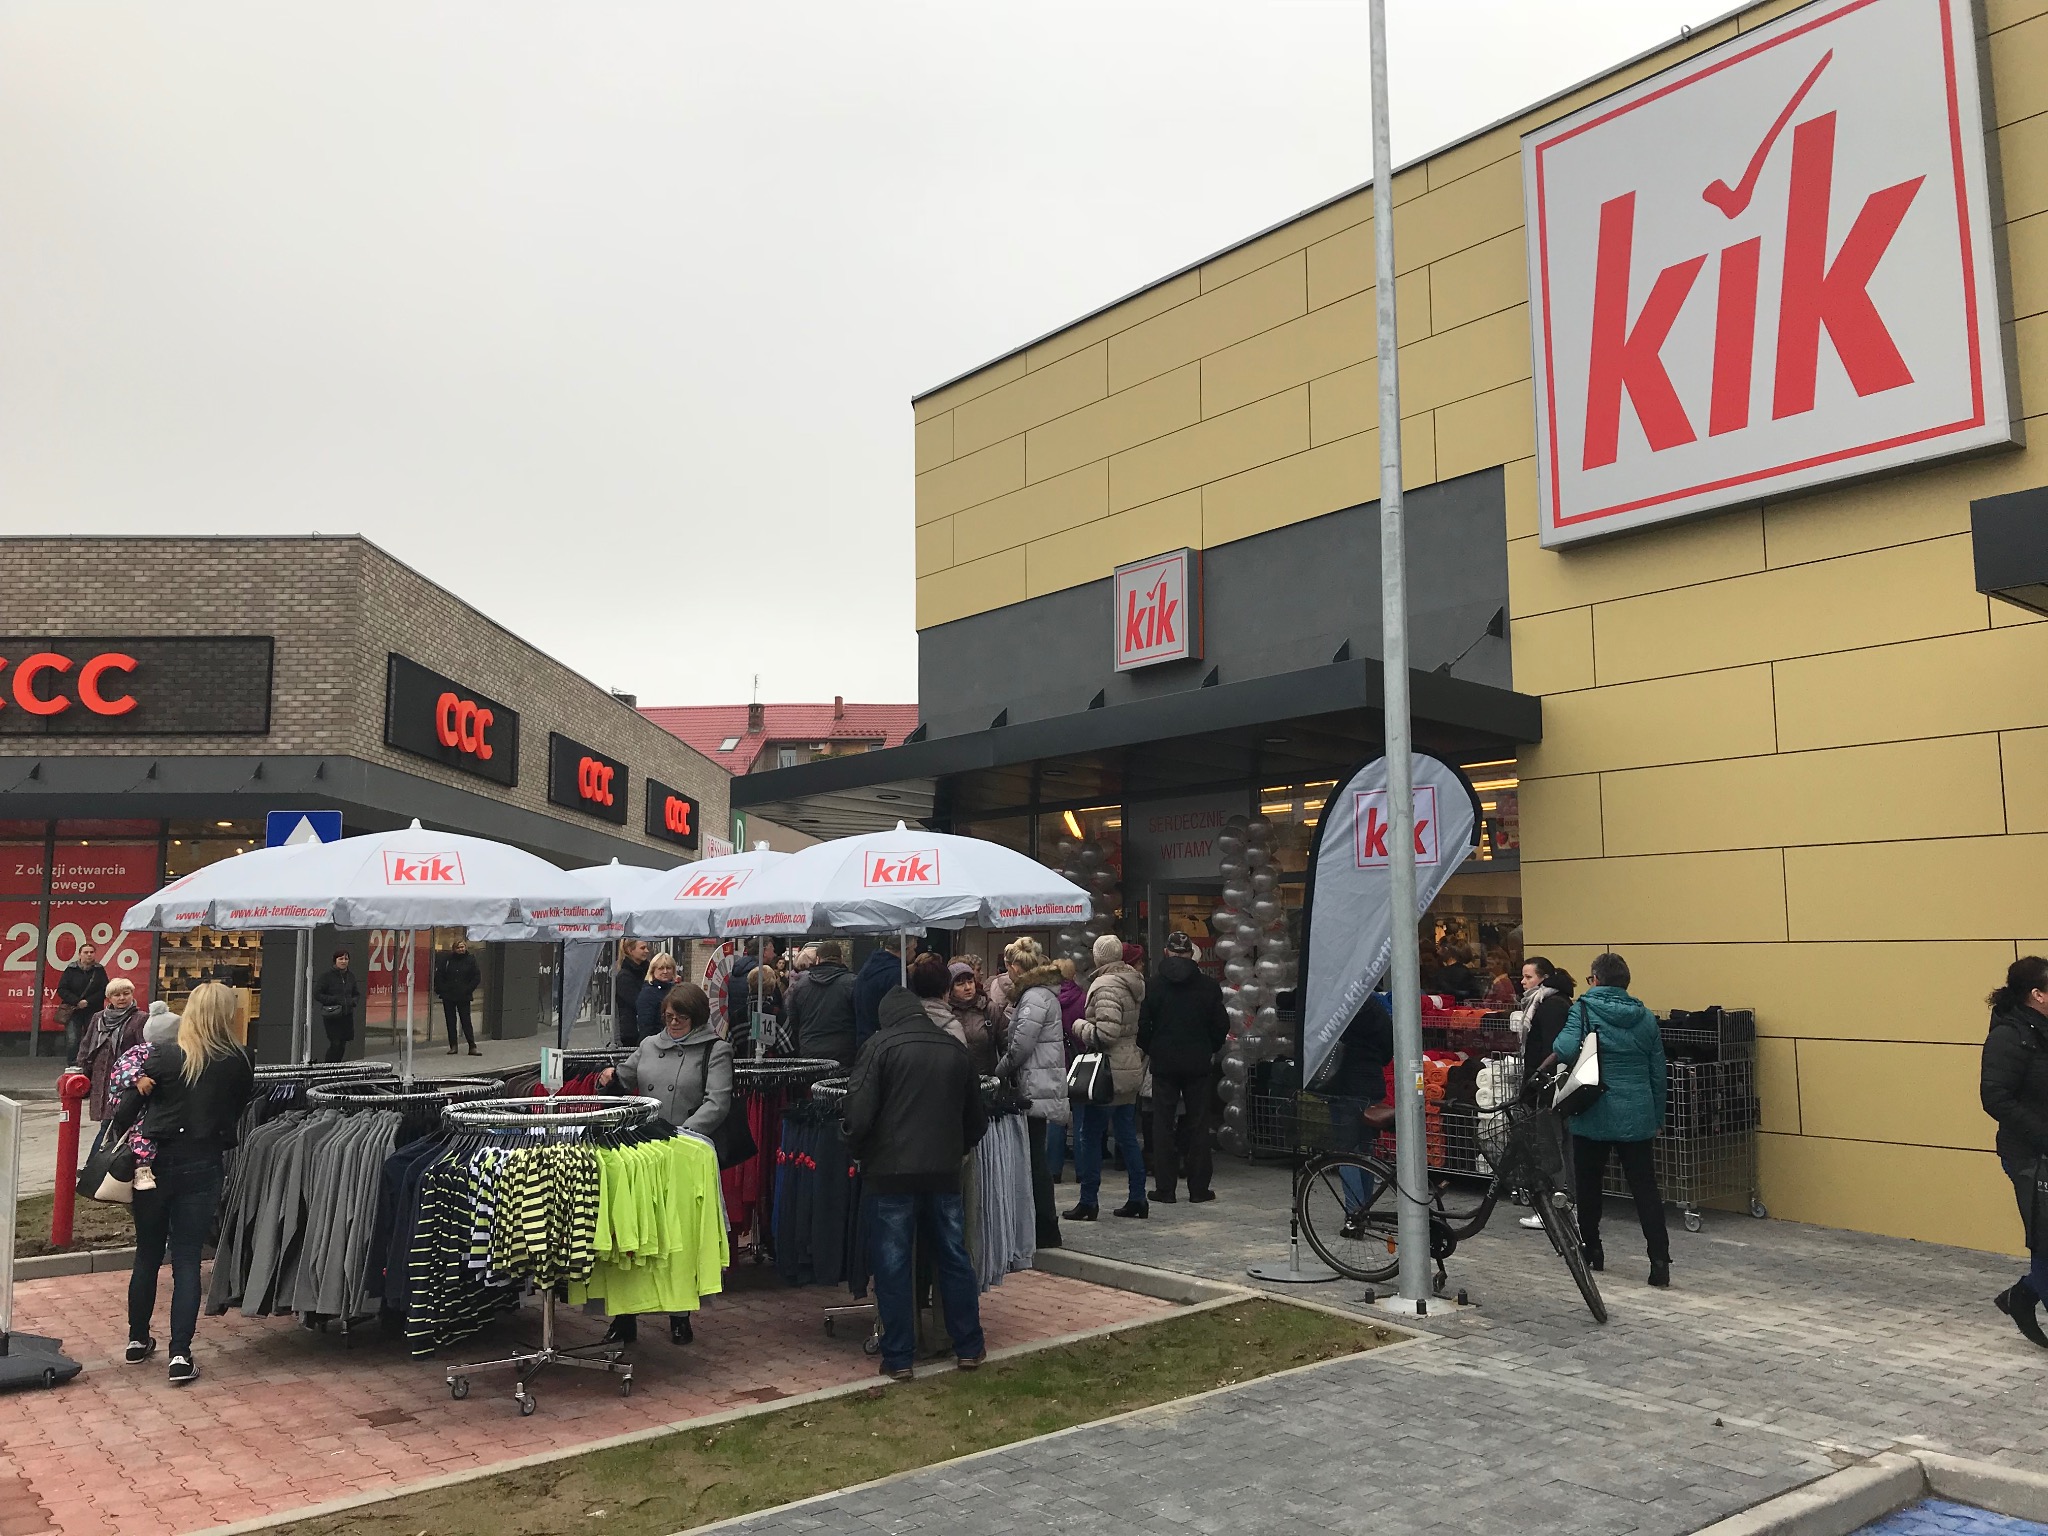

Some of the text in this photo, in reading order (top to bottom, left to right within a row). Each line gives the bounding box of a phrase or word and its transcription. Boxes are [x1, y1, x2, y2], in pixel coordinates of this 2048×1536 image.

[1583, 48, 1927, 471] kik
[1125, 569, 1179, 653] kik
[0, 653, 139, 715] CC
[436, 692, 494, 760] CCC
[578, 757, 614, 806] CCC
[665, 796, 691, 836] CCC
[1150, 810, 1226, 833] SERDECZNIE
[1160, 840, 1213, 860] WITAMY
[15, 864, 126, 879] Z okzji otwarcia
[394, 853, 456, 881] kik
[872, 853, 933, 883] kik
[51, 881, 96, 892] owego
[682, 872, 739, 897] kik
[229, 904, 328, 920] www.kik-textilien.com
[999, 903, 1083, 918] www.kik-textilien.com
[8, 986, 57, 999] na bty
